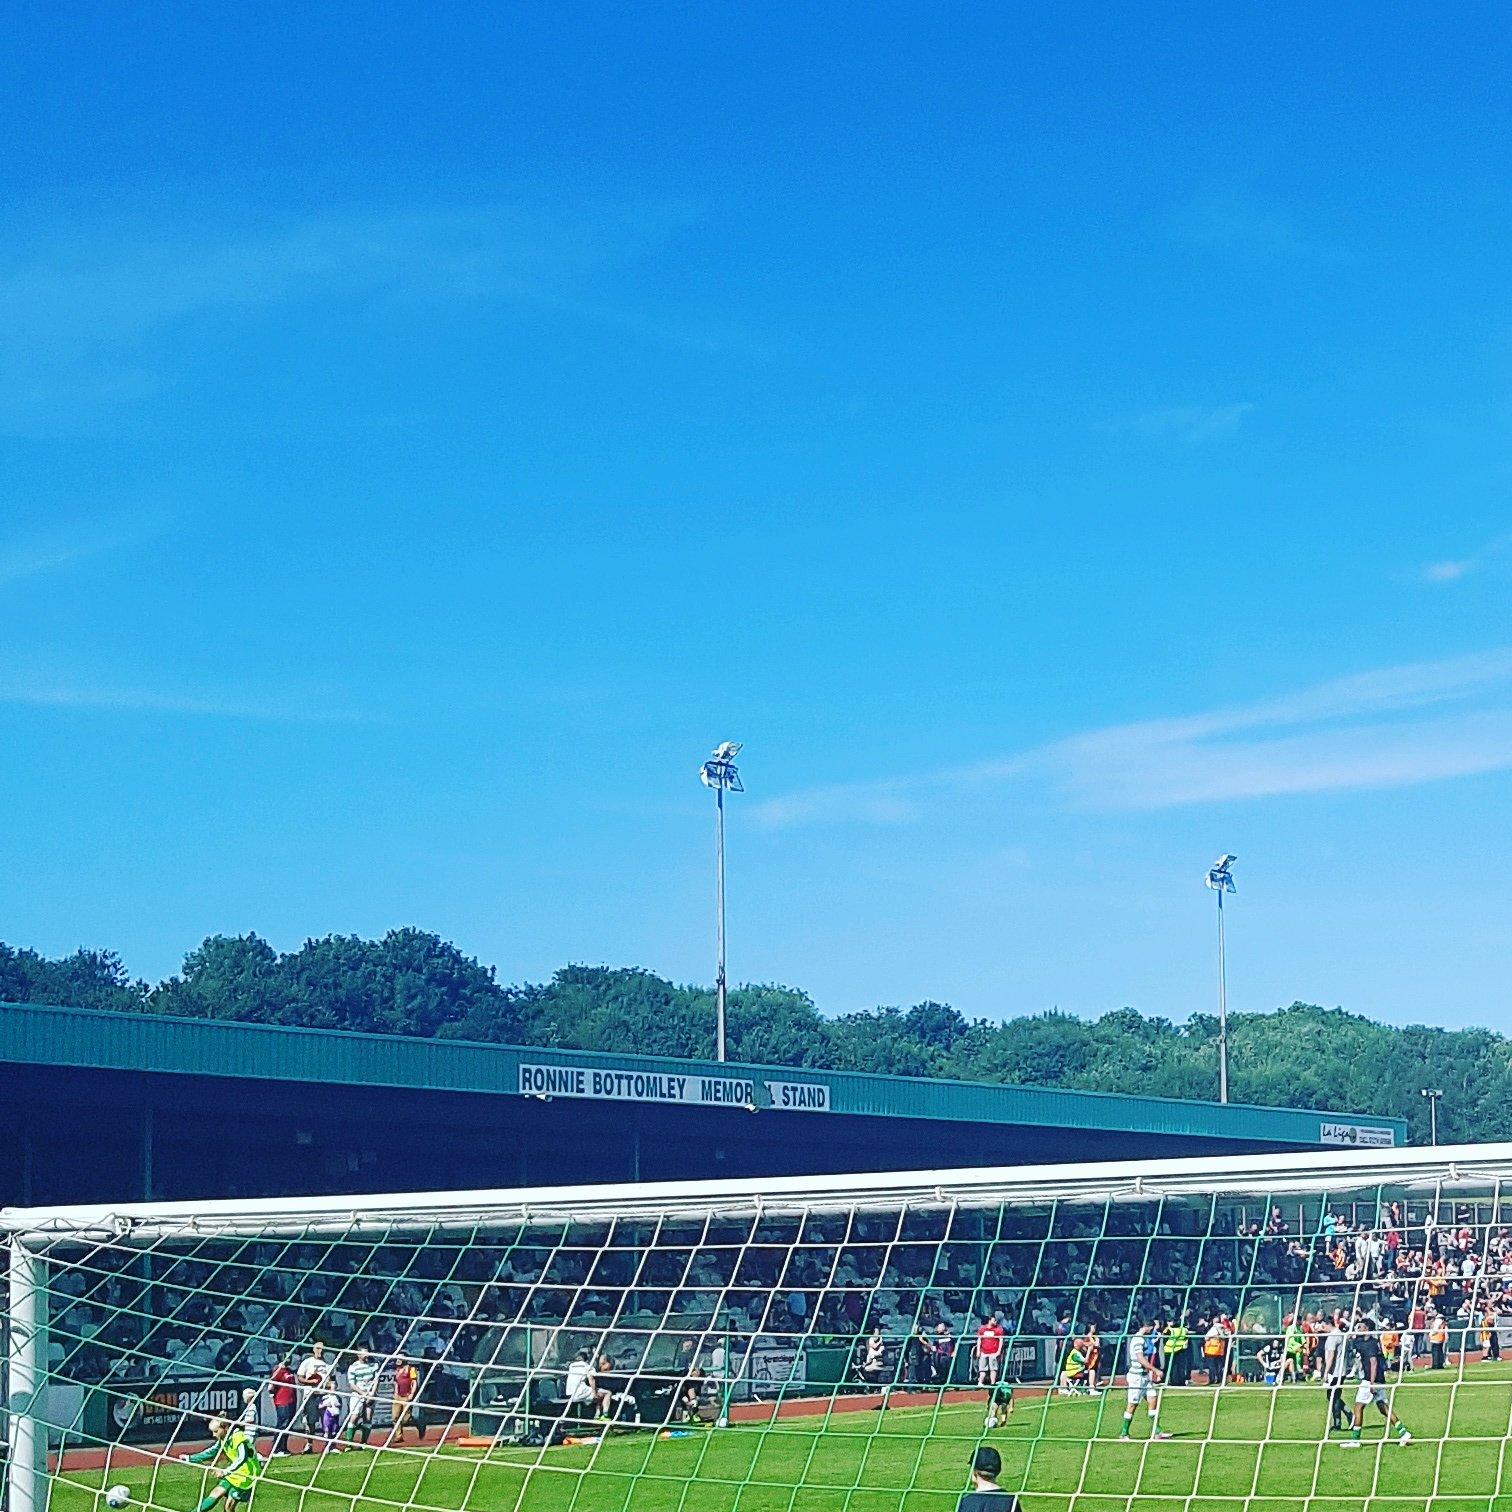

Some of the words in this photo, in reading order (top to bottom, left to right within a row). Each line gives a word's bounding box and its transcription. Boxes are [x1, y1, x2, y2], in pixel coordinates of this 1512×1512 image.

[522, 1067, 585, 1094] RONNIE
[592, 1072, 687, 1099] BOTTOMLEY
[782, 1085, 826, 1108] STAND
